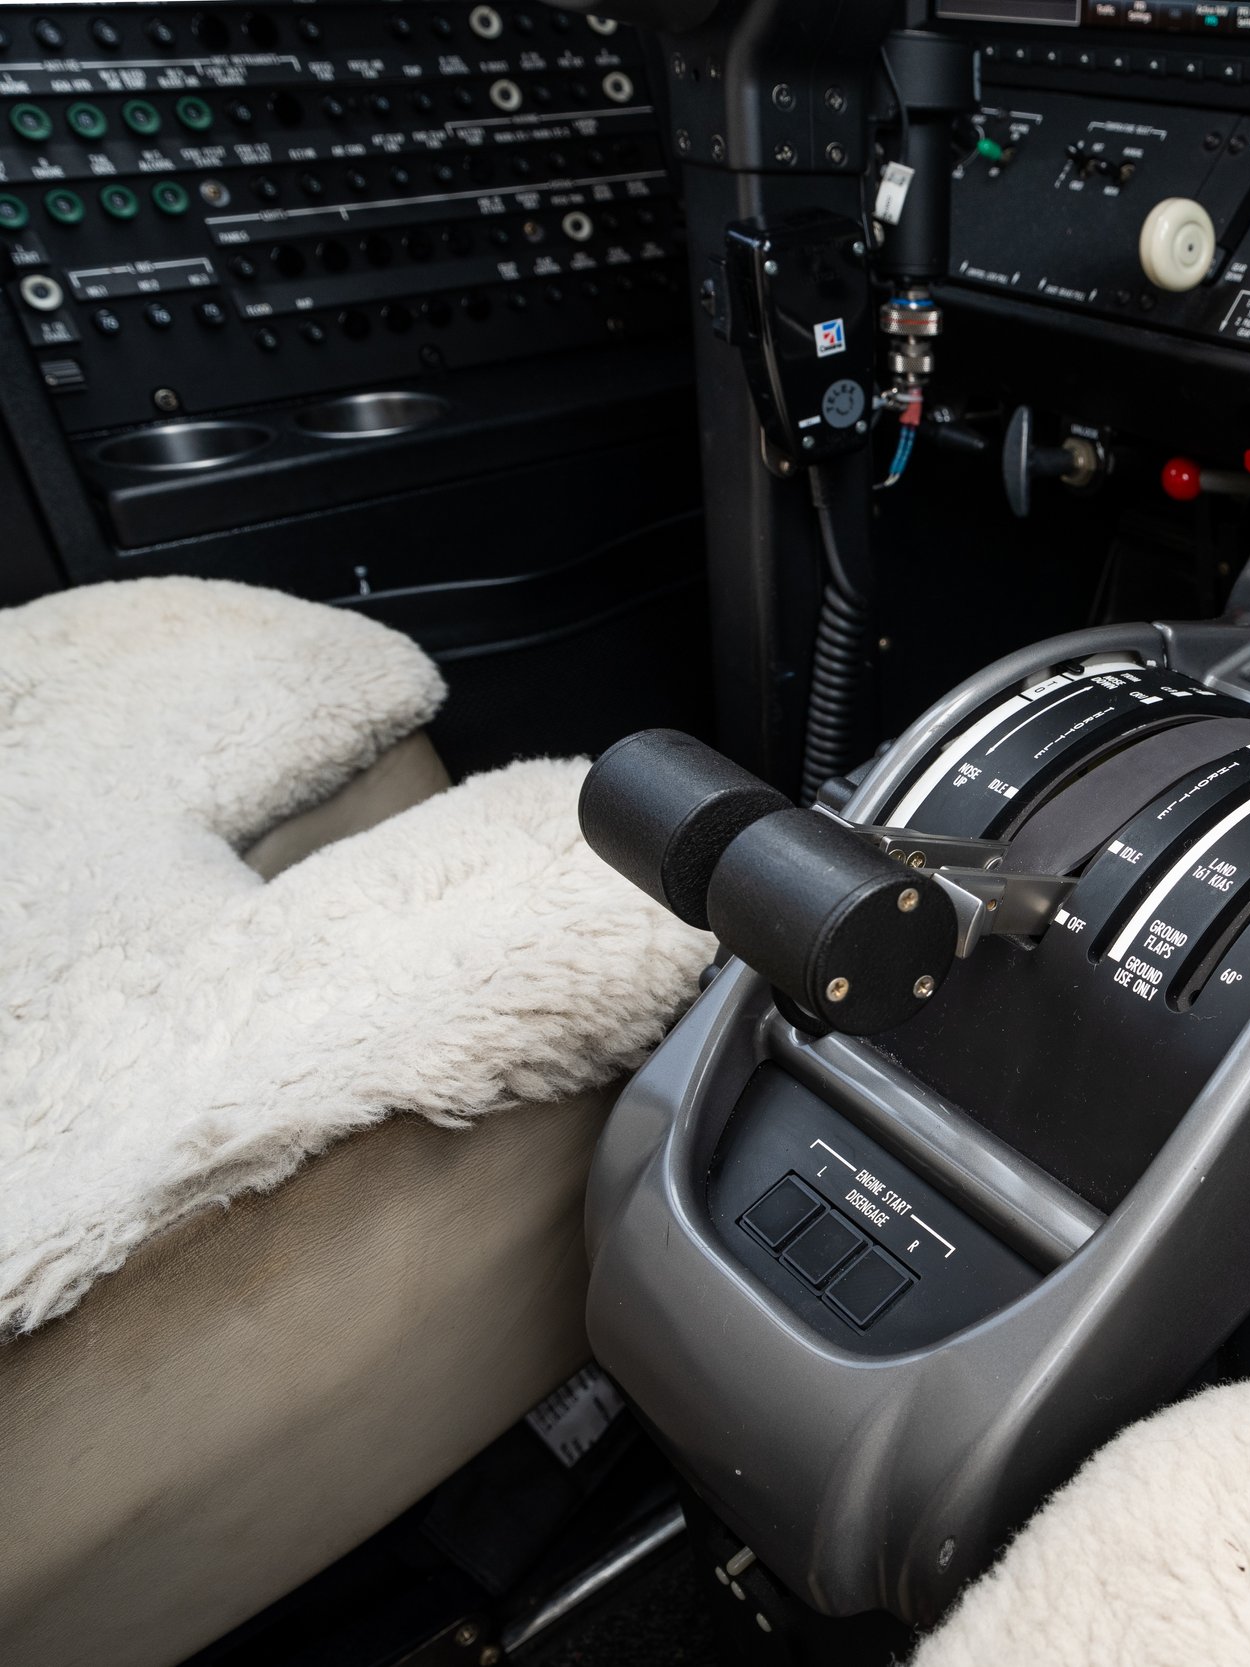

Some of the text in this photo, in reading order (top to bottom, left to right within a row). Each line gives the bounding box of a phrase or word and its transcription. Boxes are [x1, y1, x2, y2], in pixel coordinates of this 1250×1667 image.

[1091, 676, 1119, 690] DOWN
[1102, 675, 1127, 687] NOSE
[1120, 673, 1142, 683] TRIM
[1129, 691, 1149, 700] CRU
[1034, 707, 1115, 760] THROTTLE
[958, 762, 982, 781] NOSE
[953, 775, 968, 788] UP
[988, 778, 1009, 794] IDLE
[1157, 761, 1240, 820] THROTTLE
[1119, 846, 1143, 864] IDLE
[1208, 858, 1237, 877] LAND
[1192, 865, 1234, 892] 161 KIAS
[1067, 916, 1086, 934] OFF
[1149, 919, 1188, 947] GROUND
[1143, 936, 1175, 959] FLAPS
[1125, 955, 1163, 985] GROUND
[1220, 968, 1243, 984] 60°
[1113, 967, 1159, 1001] USE ONLY
[816, 1165, 827, 1178] L
[855, 1169, 912, 1216] ENGINE START
[845, 1189, 890, 1228] DISENGAGE
[907, 1240, 920, 1253] R
